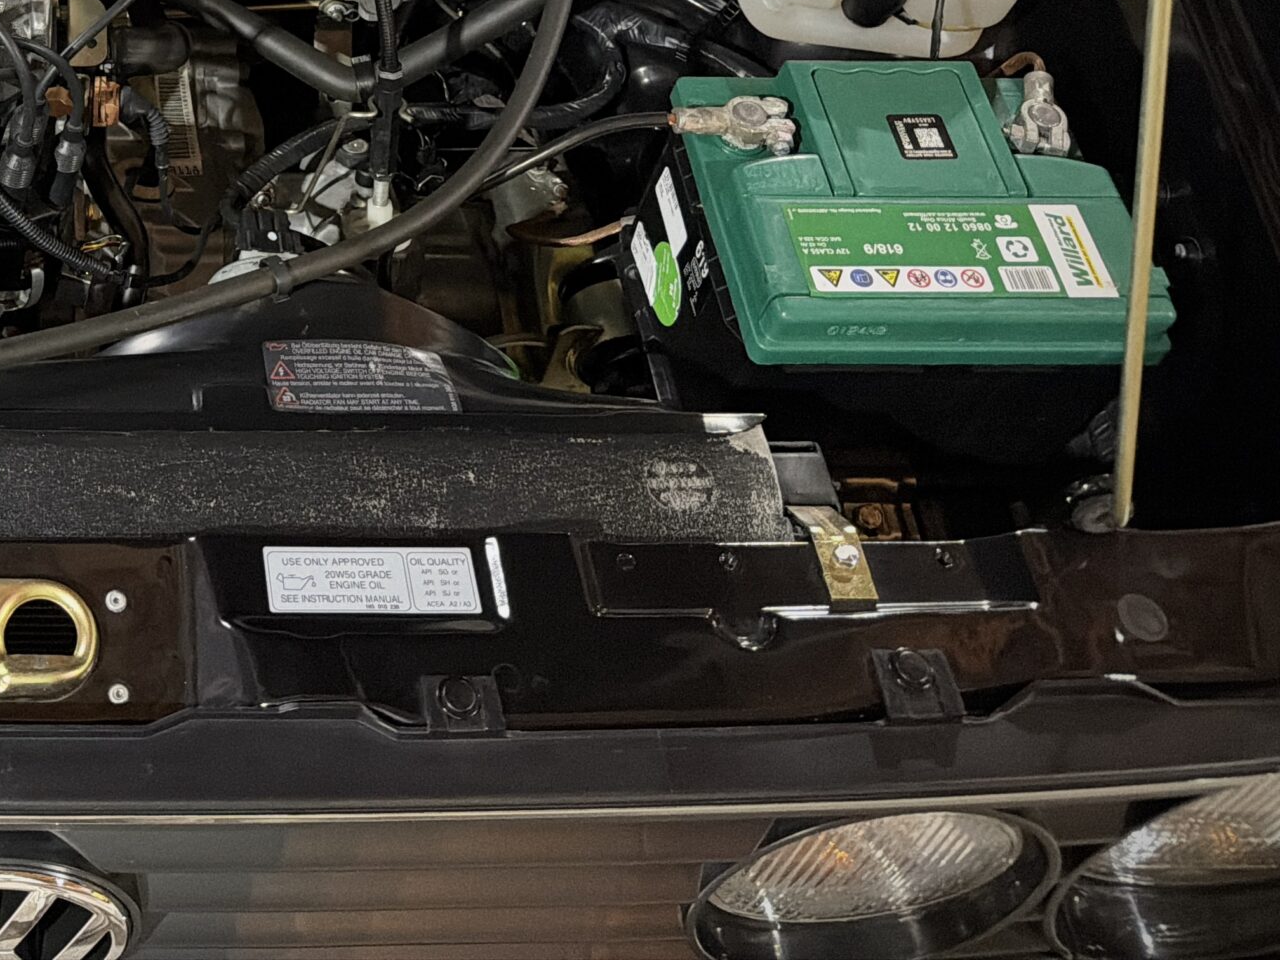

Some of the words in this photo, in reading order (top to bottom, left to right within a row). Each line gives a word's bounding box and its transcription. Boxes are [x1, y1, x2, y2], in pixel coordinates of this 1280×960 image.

[907, 222, 922, 231] 12
[926, 222, 941, 232] 00
[943, 222, 958, 231] 12
[962, 222, 992, 231] 0860
[863, 243, 904, 255] 618/9
[1044, 211, 1095, 286] Willard
[282, 557, 300, 567] USE
[303, 557, 328, 567] ONLY
[331, 557, 384, 567] APPROVED
[409, 557, 425, 567] OIL
[427, 557, 466, 567] QUALITY
[358, 570, 392, 579] GRADE
[329, 581, 366, 590] ENGINE
[368, 581, 386, 590] OIL
[281, 594, 299, 603] SEE
[301, 594, 362, 604] INSTRUCTION
[365, 594, 403, 604] MANUAL
